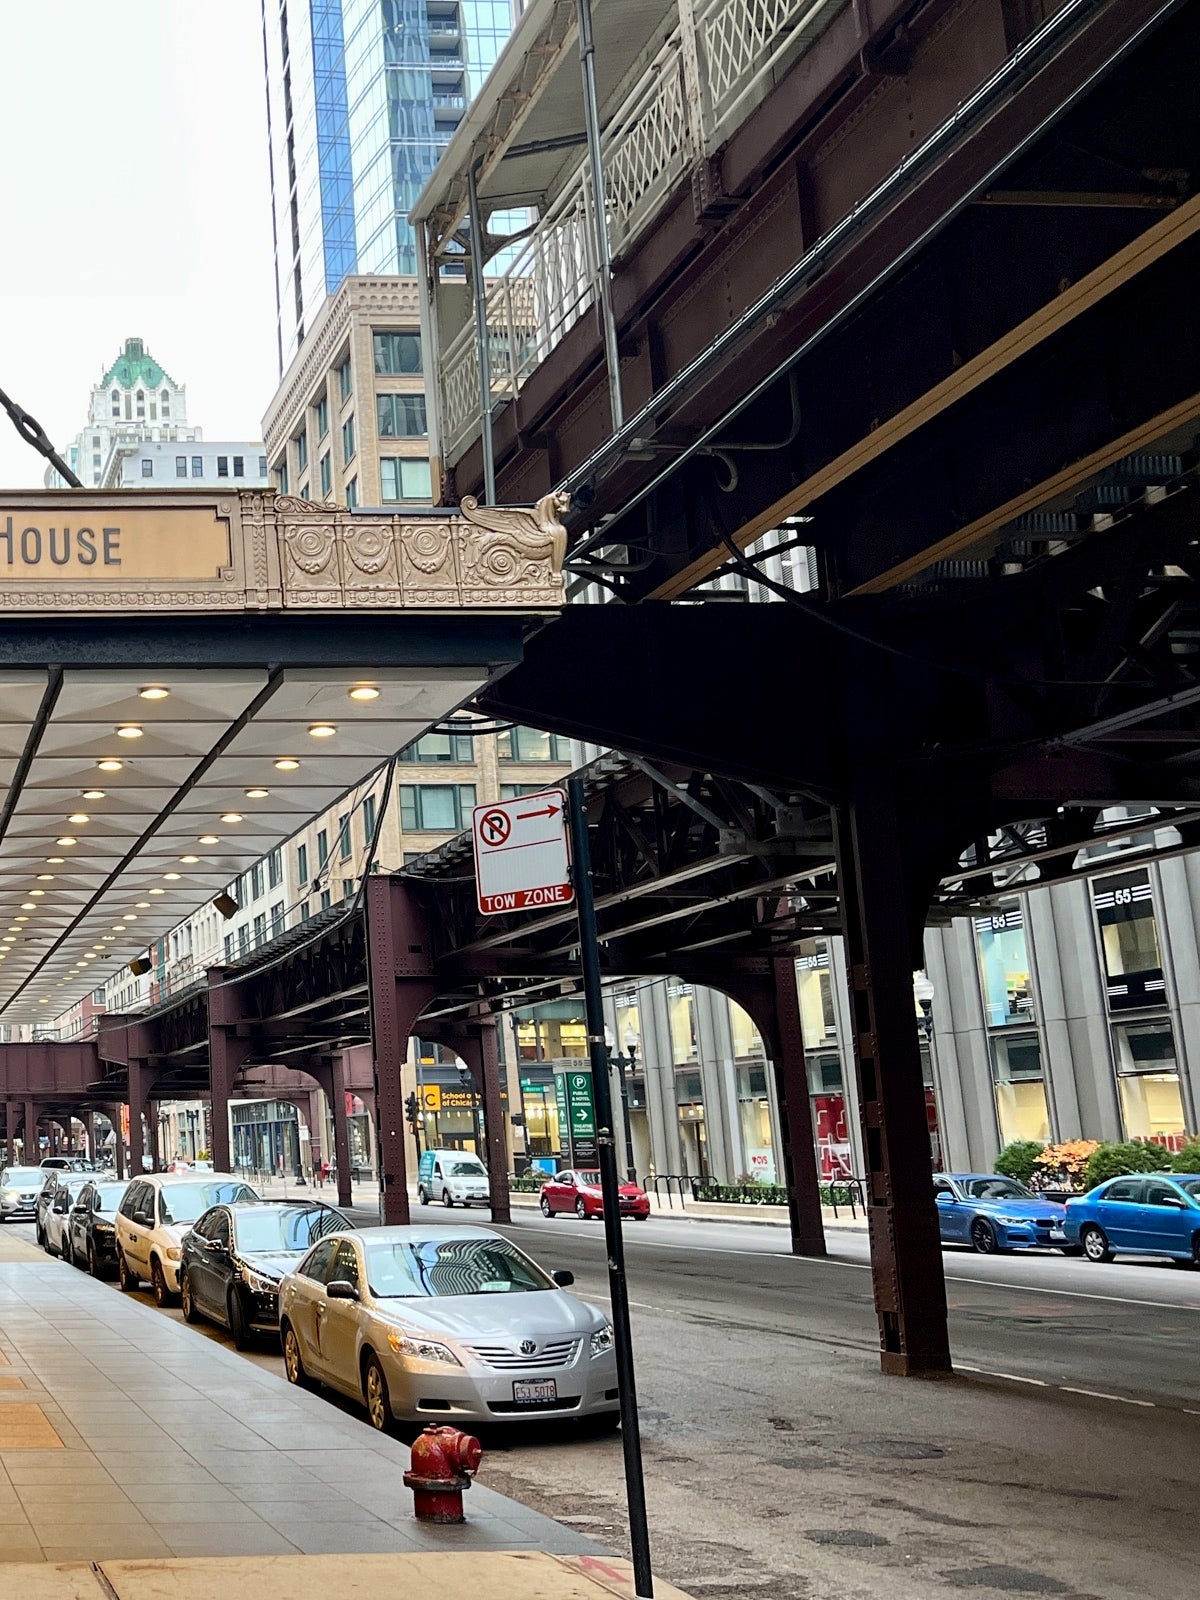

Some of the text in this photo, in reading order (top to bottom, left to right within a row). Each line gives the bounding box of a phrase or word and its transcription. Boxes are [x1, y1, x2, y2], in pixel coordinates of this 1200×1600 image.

[485, 886, 565, 911] TOW ZONE
[1114, 888, 1133, 905] 55
[992, 915, 1006, 929] 55
[441, 1092, 465, 1100] School
[756, 1155, 768, 1165] CVS
